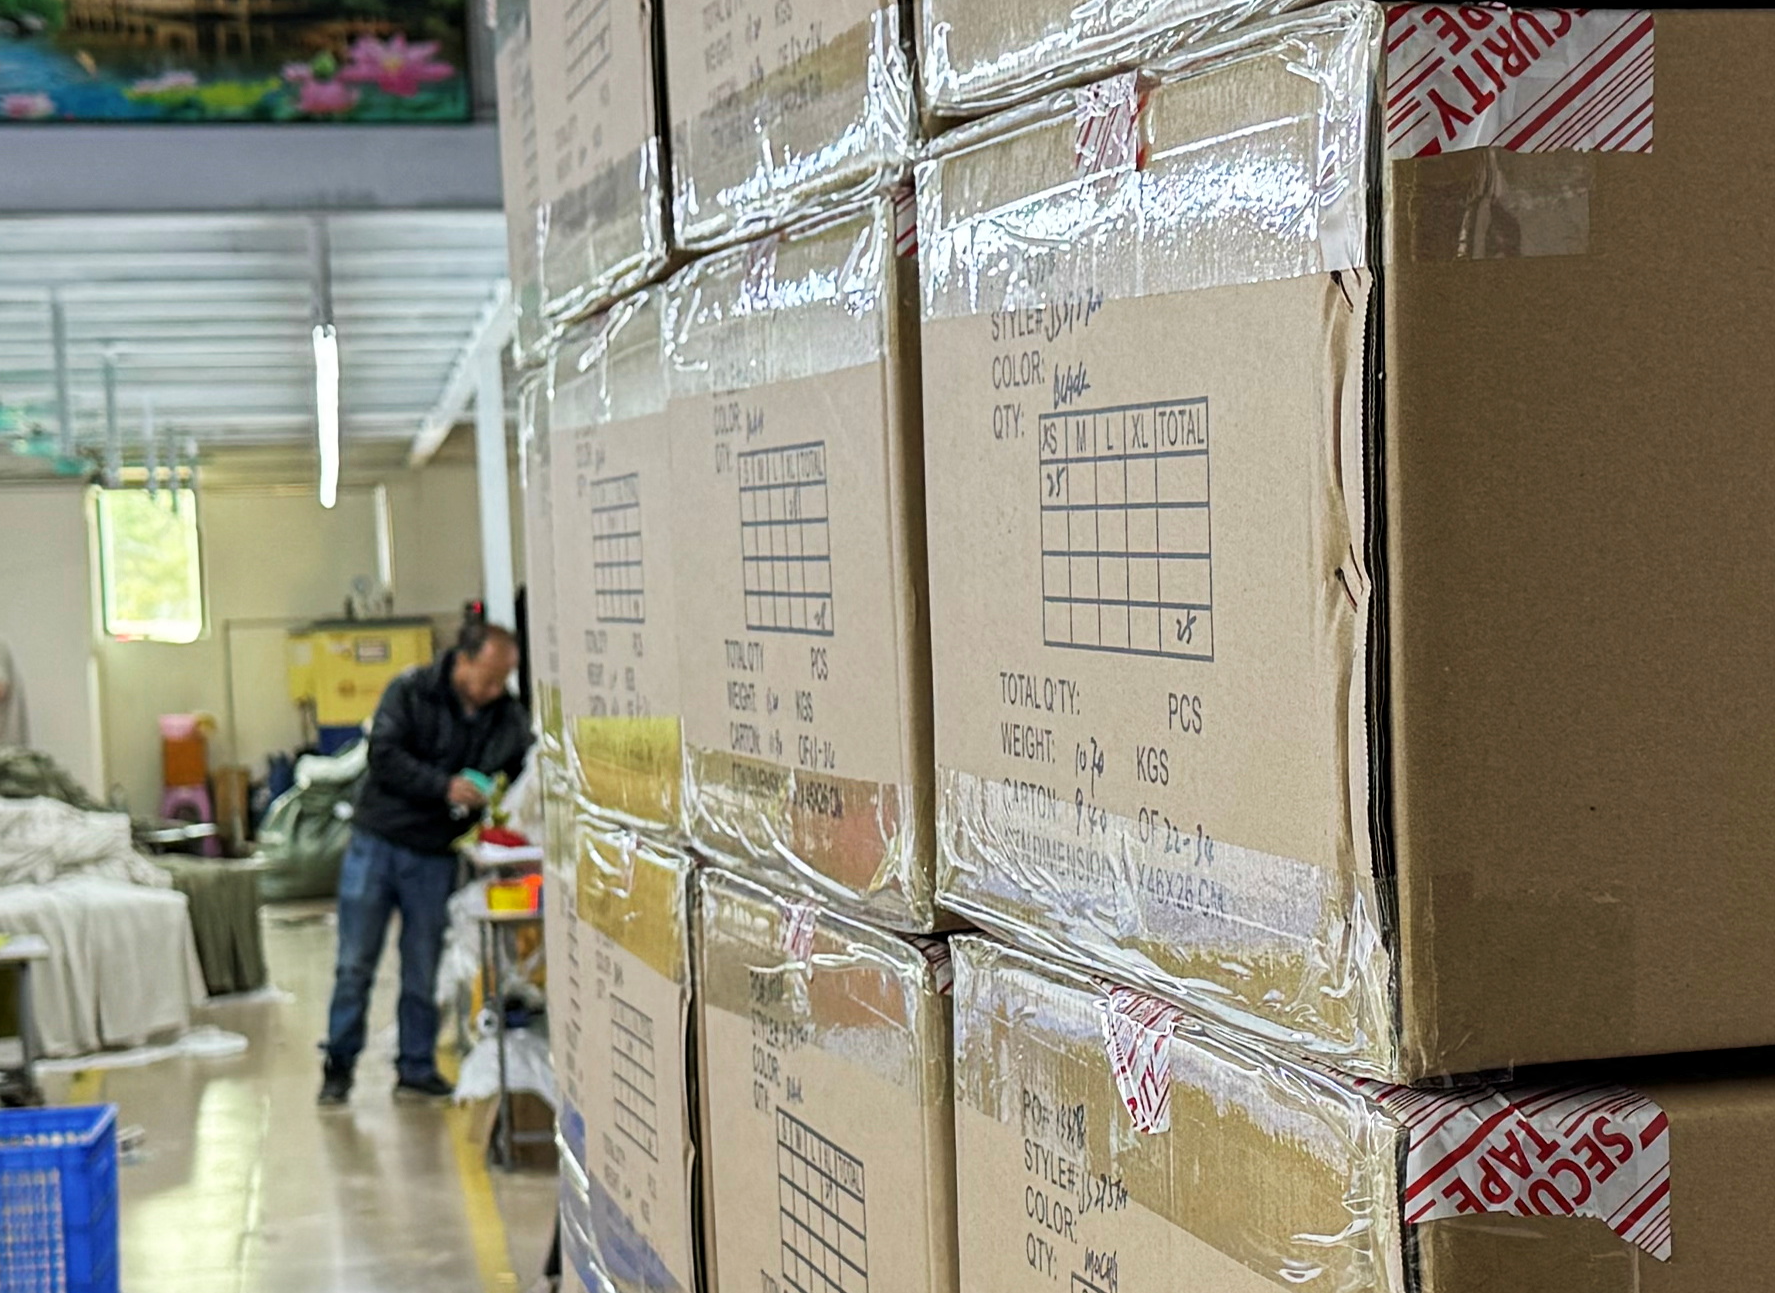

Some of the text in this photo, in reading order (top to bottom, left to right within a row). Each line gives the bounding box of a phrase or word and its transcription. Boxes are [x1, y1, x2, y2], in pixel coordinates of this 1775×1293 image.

[992, 350, 1045, 390] COLOR:
[993, 402, 1025, 439] QTY:
[1076, 420, 1087, 453] M
[1106, 418, 1114, 451] L
[1132, 413, 1149, 449] XL
[1159, 406, 1205, 447] TOTAL
[811, 647, 829, 681] PCS
[1000, 671, 1042, 710] TOTAL
[1168, 692, 1203, 734] PCS
[1000, 721, 1170, 786] WEIGHT: KGS
[1138, 807, 1159, 844] OF
[1024, 1137, 1079, 1198] STYLE#:
[1441, 1118, 1561, 1214] TAPE
[1026, 1185, 1077, 1244] COLOR:
[1026, 1232, 1058, 1281] QTY:
